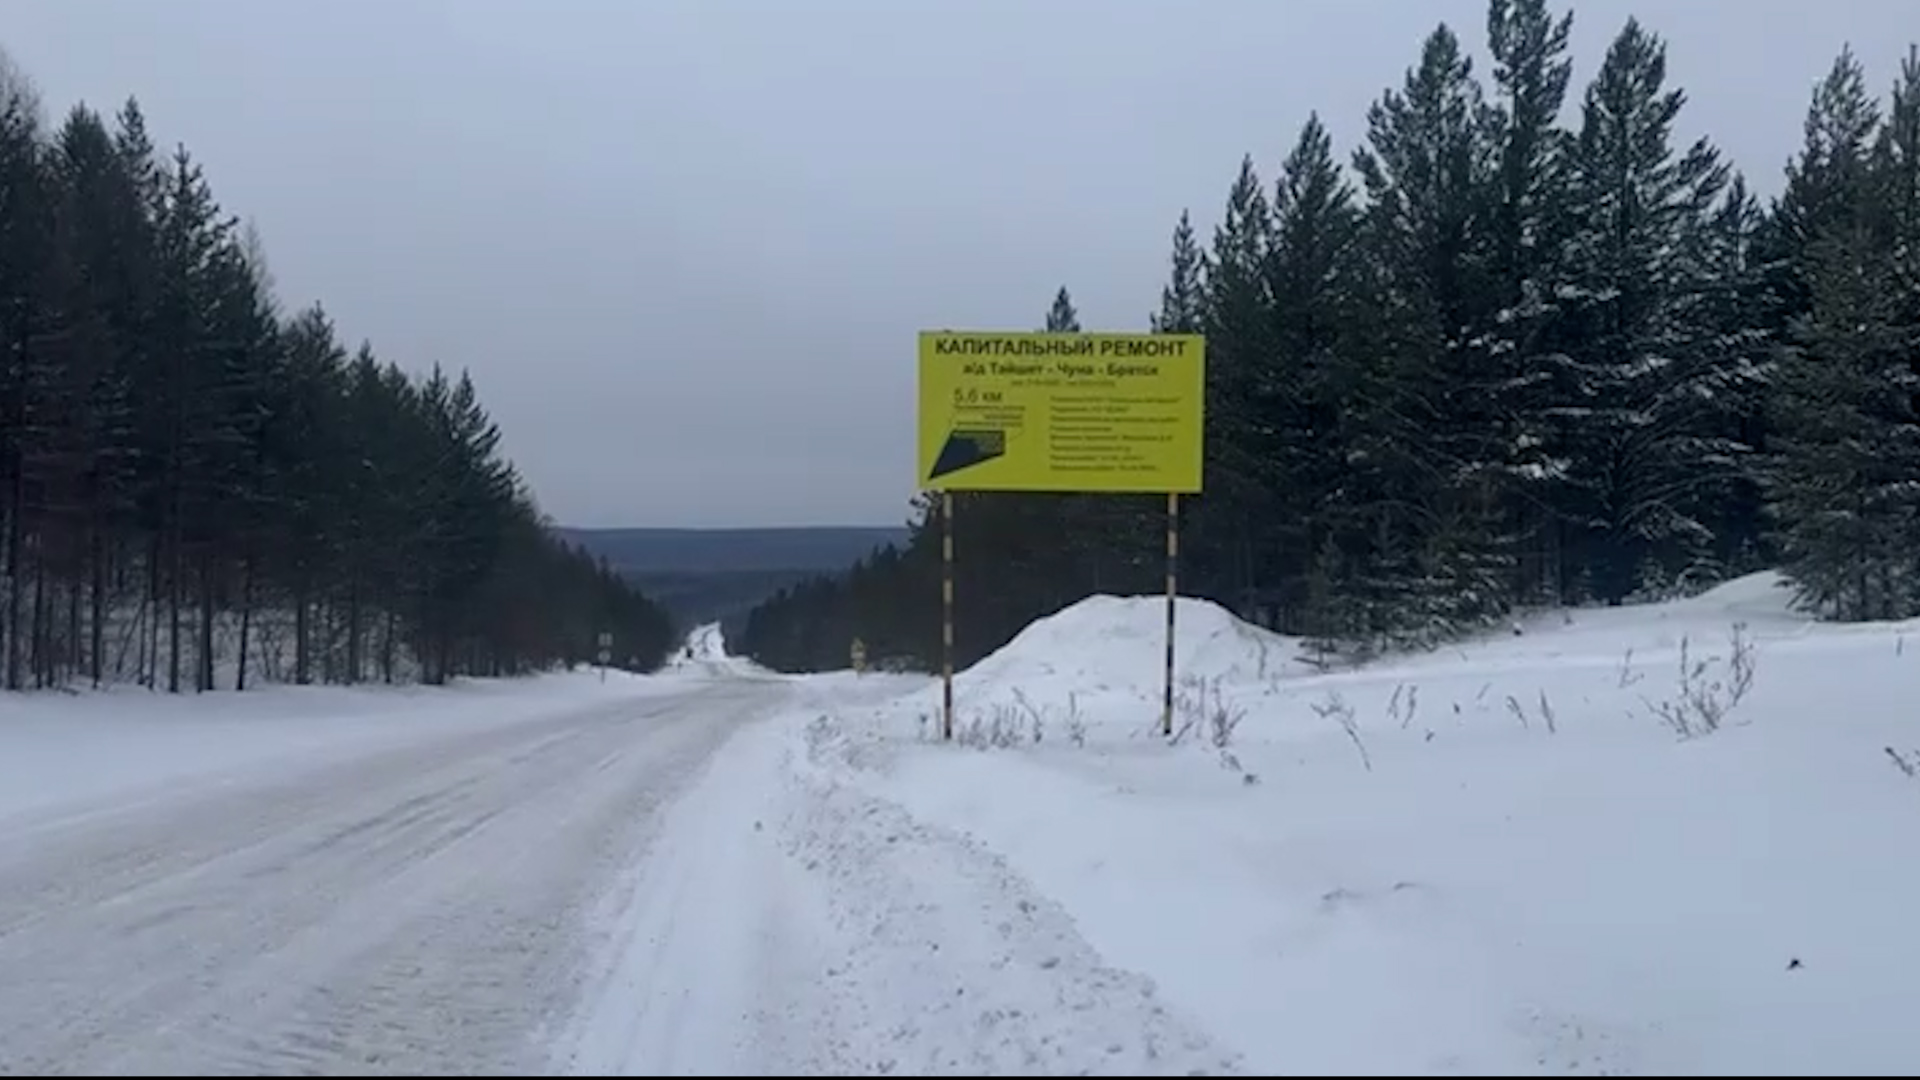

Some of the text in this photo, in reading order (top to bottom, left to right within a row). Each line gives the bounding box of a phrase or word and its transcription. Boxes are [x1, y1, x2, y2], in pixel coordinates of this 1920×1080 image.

[935, 335, 1187, 358] КАПИТАЛЬНЫЙ РЕМОНТ
[990, 362, 1042, 375] Тайшет
[1107, 363, 1158, 377] Братск
[982, 391, 1002, 403] км
